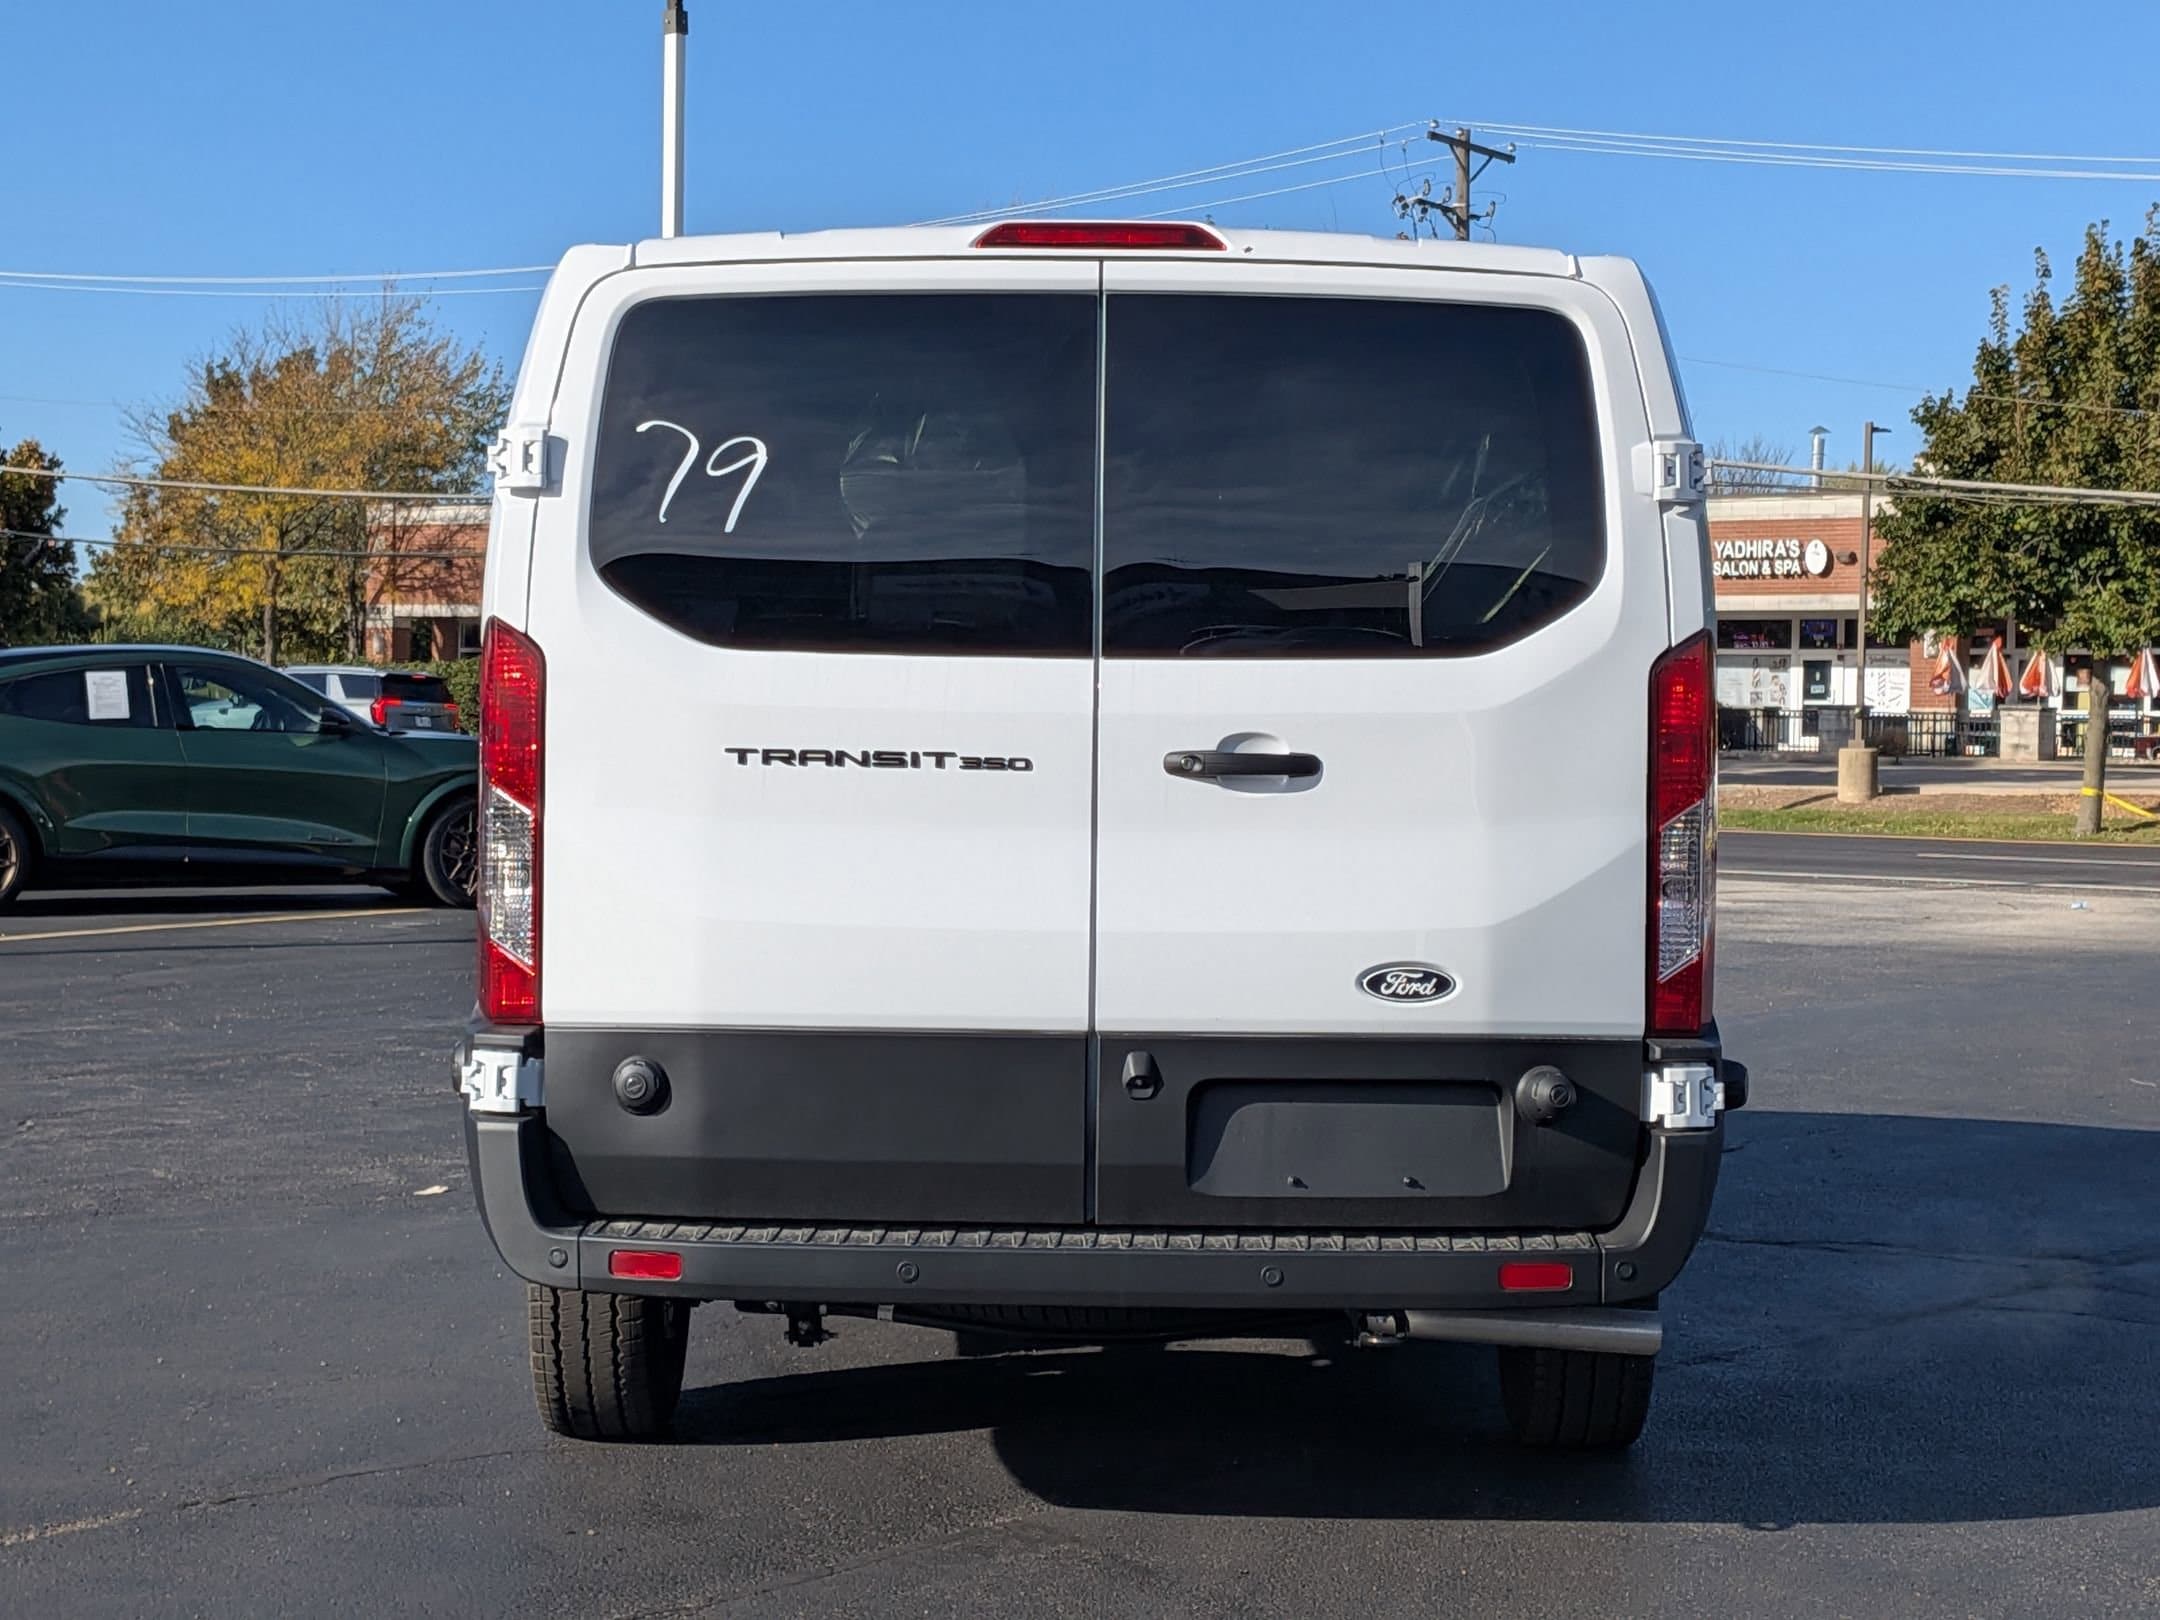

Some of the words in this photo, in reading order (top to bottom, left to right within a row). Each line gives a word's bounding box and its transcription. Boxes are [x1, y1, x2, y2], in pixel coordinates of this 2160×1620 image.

[636, 420, 768, 533] 79
[1714, 539, 1801, 559] YADHIRA'S
[1712, 560, 1759, 576] SALON
[1761, 559, 1772, 575] &
[1774, 559, 1801, 575] SPA
[724, 747, 958, 769] TRANSIT
[1380, 971, 1438, 995] Ford
